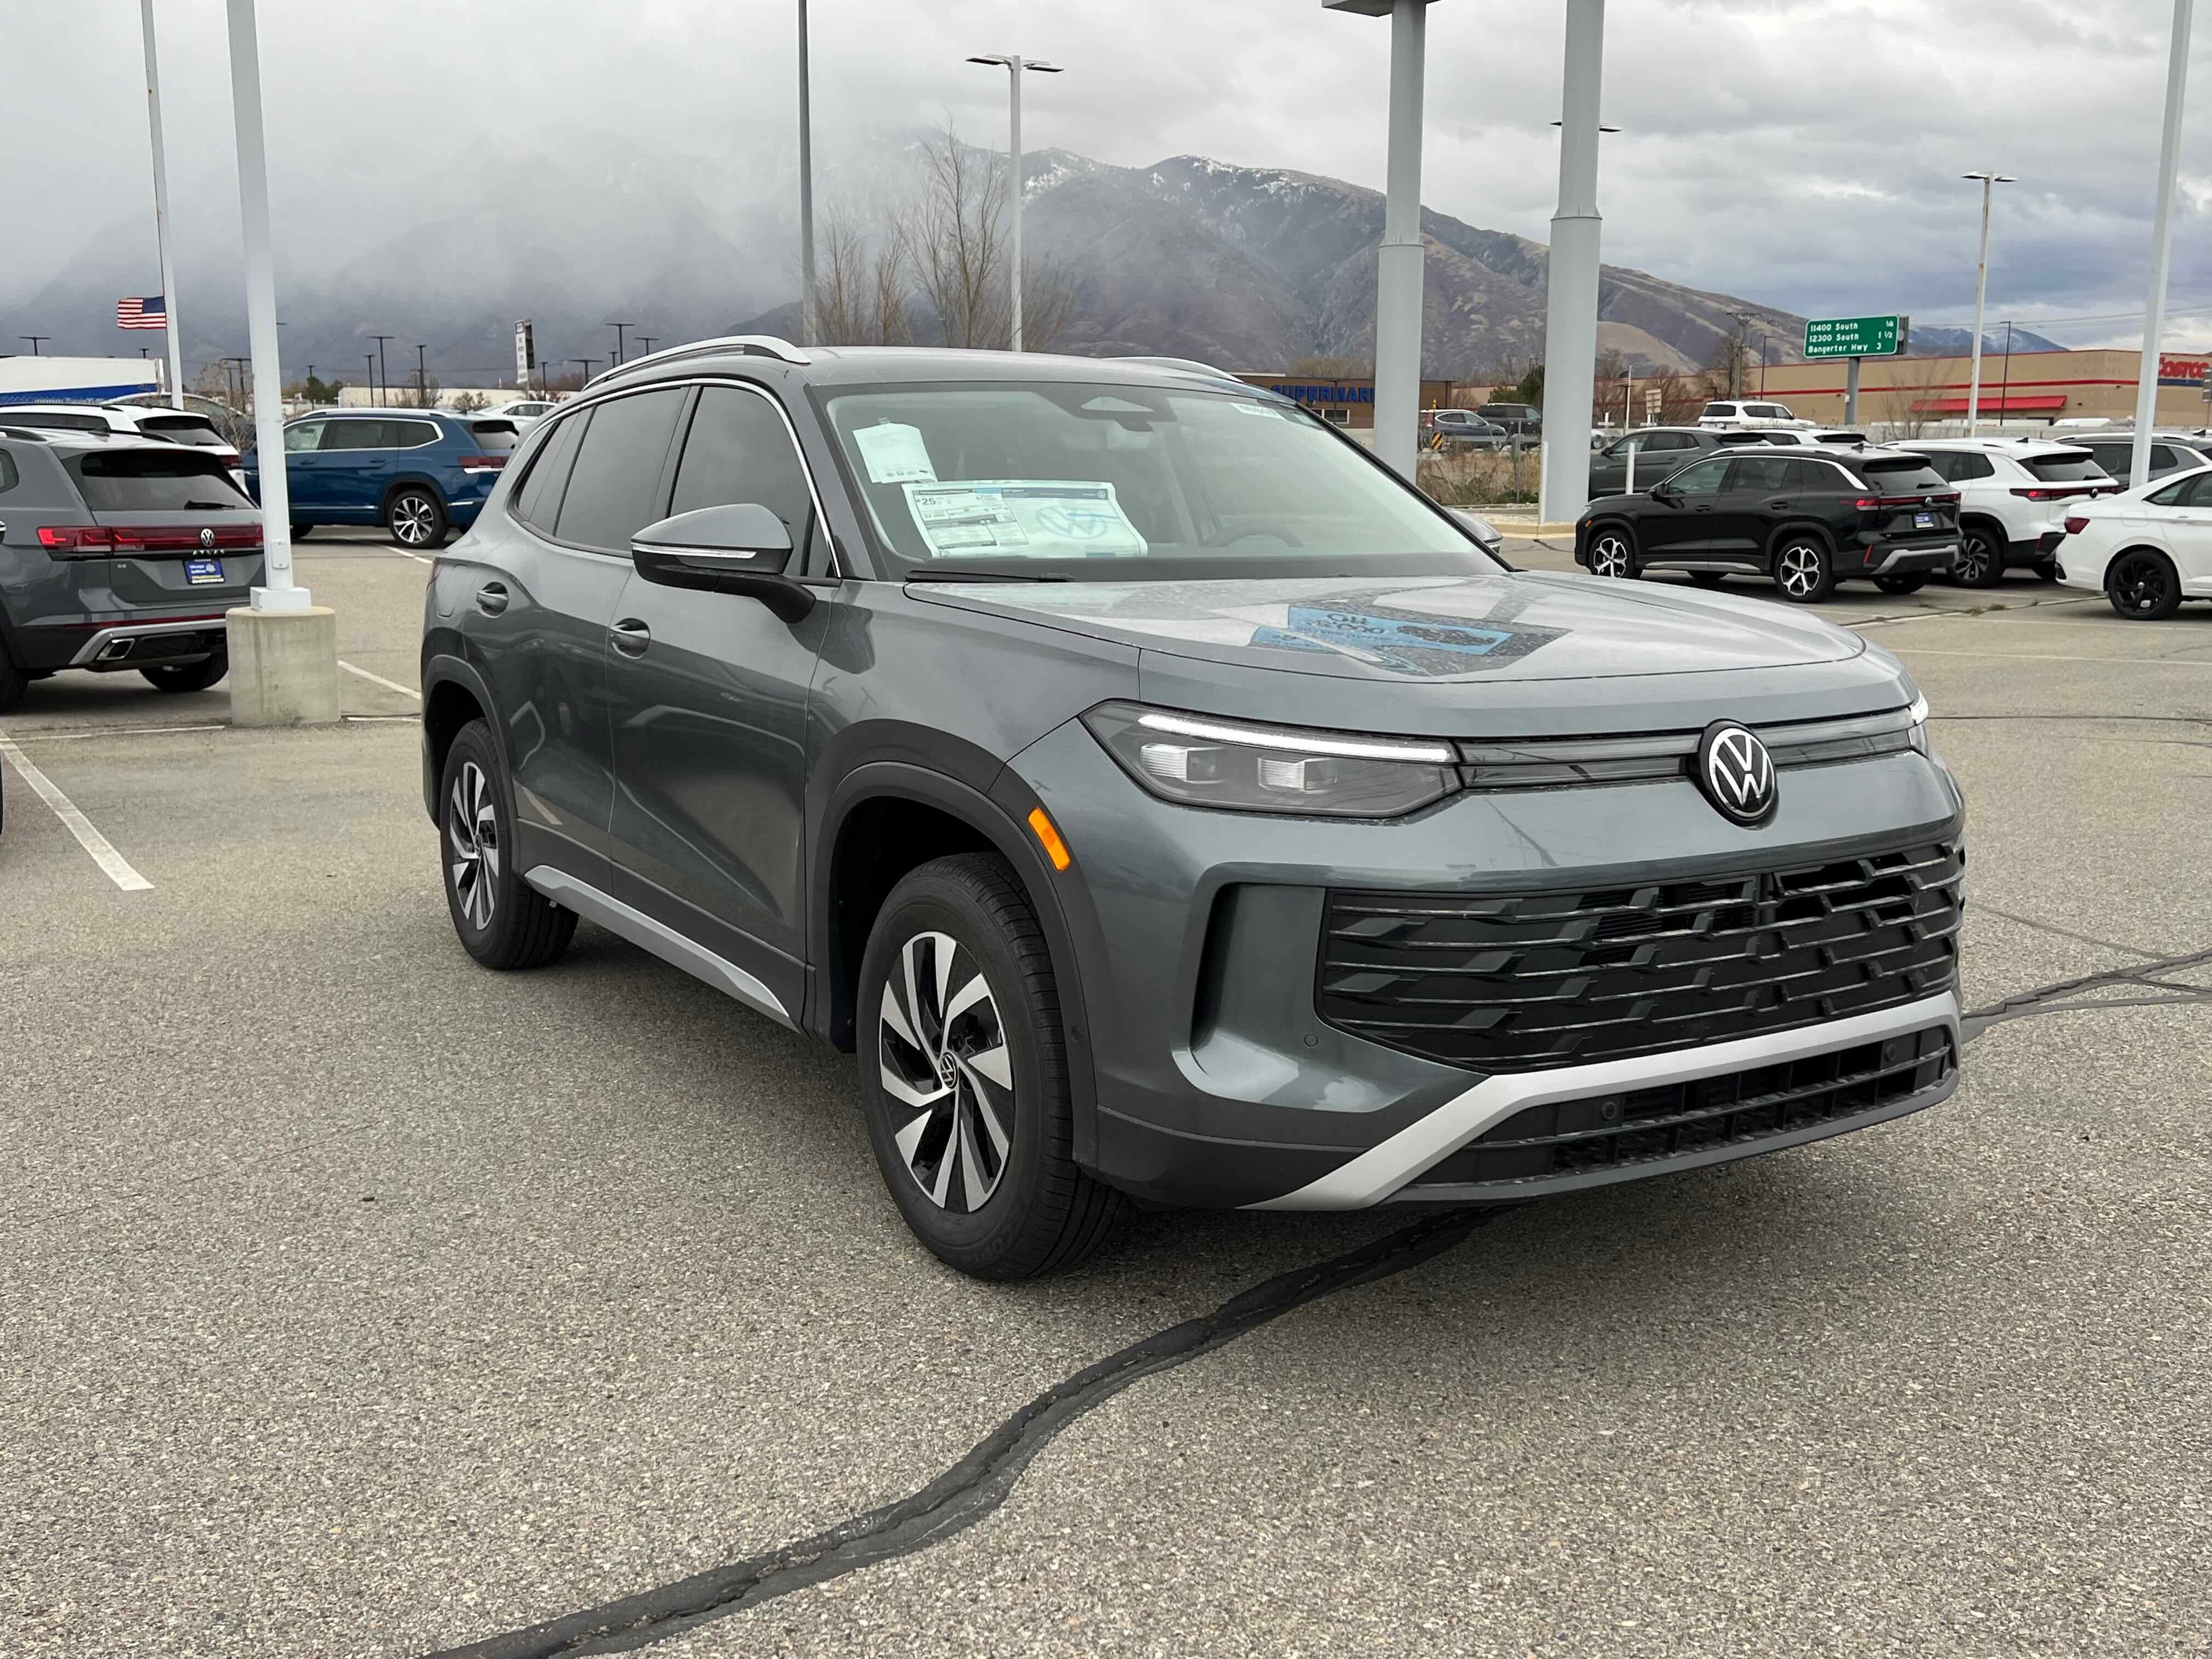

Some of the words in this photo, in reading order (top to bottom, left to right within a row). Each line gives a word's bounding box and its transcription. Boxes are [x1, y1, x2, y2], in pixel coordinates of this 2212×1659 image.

[1810, 324, 1832, 332] 11400
[1809, 334, 1832, 343] 12300
[1808, 345, 1847, 354] Bangerter
